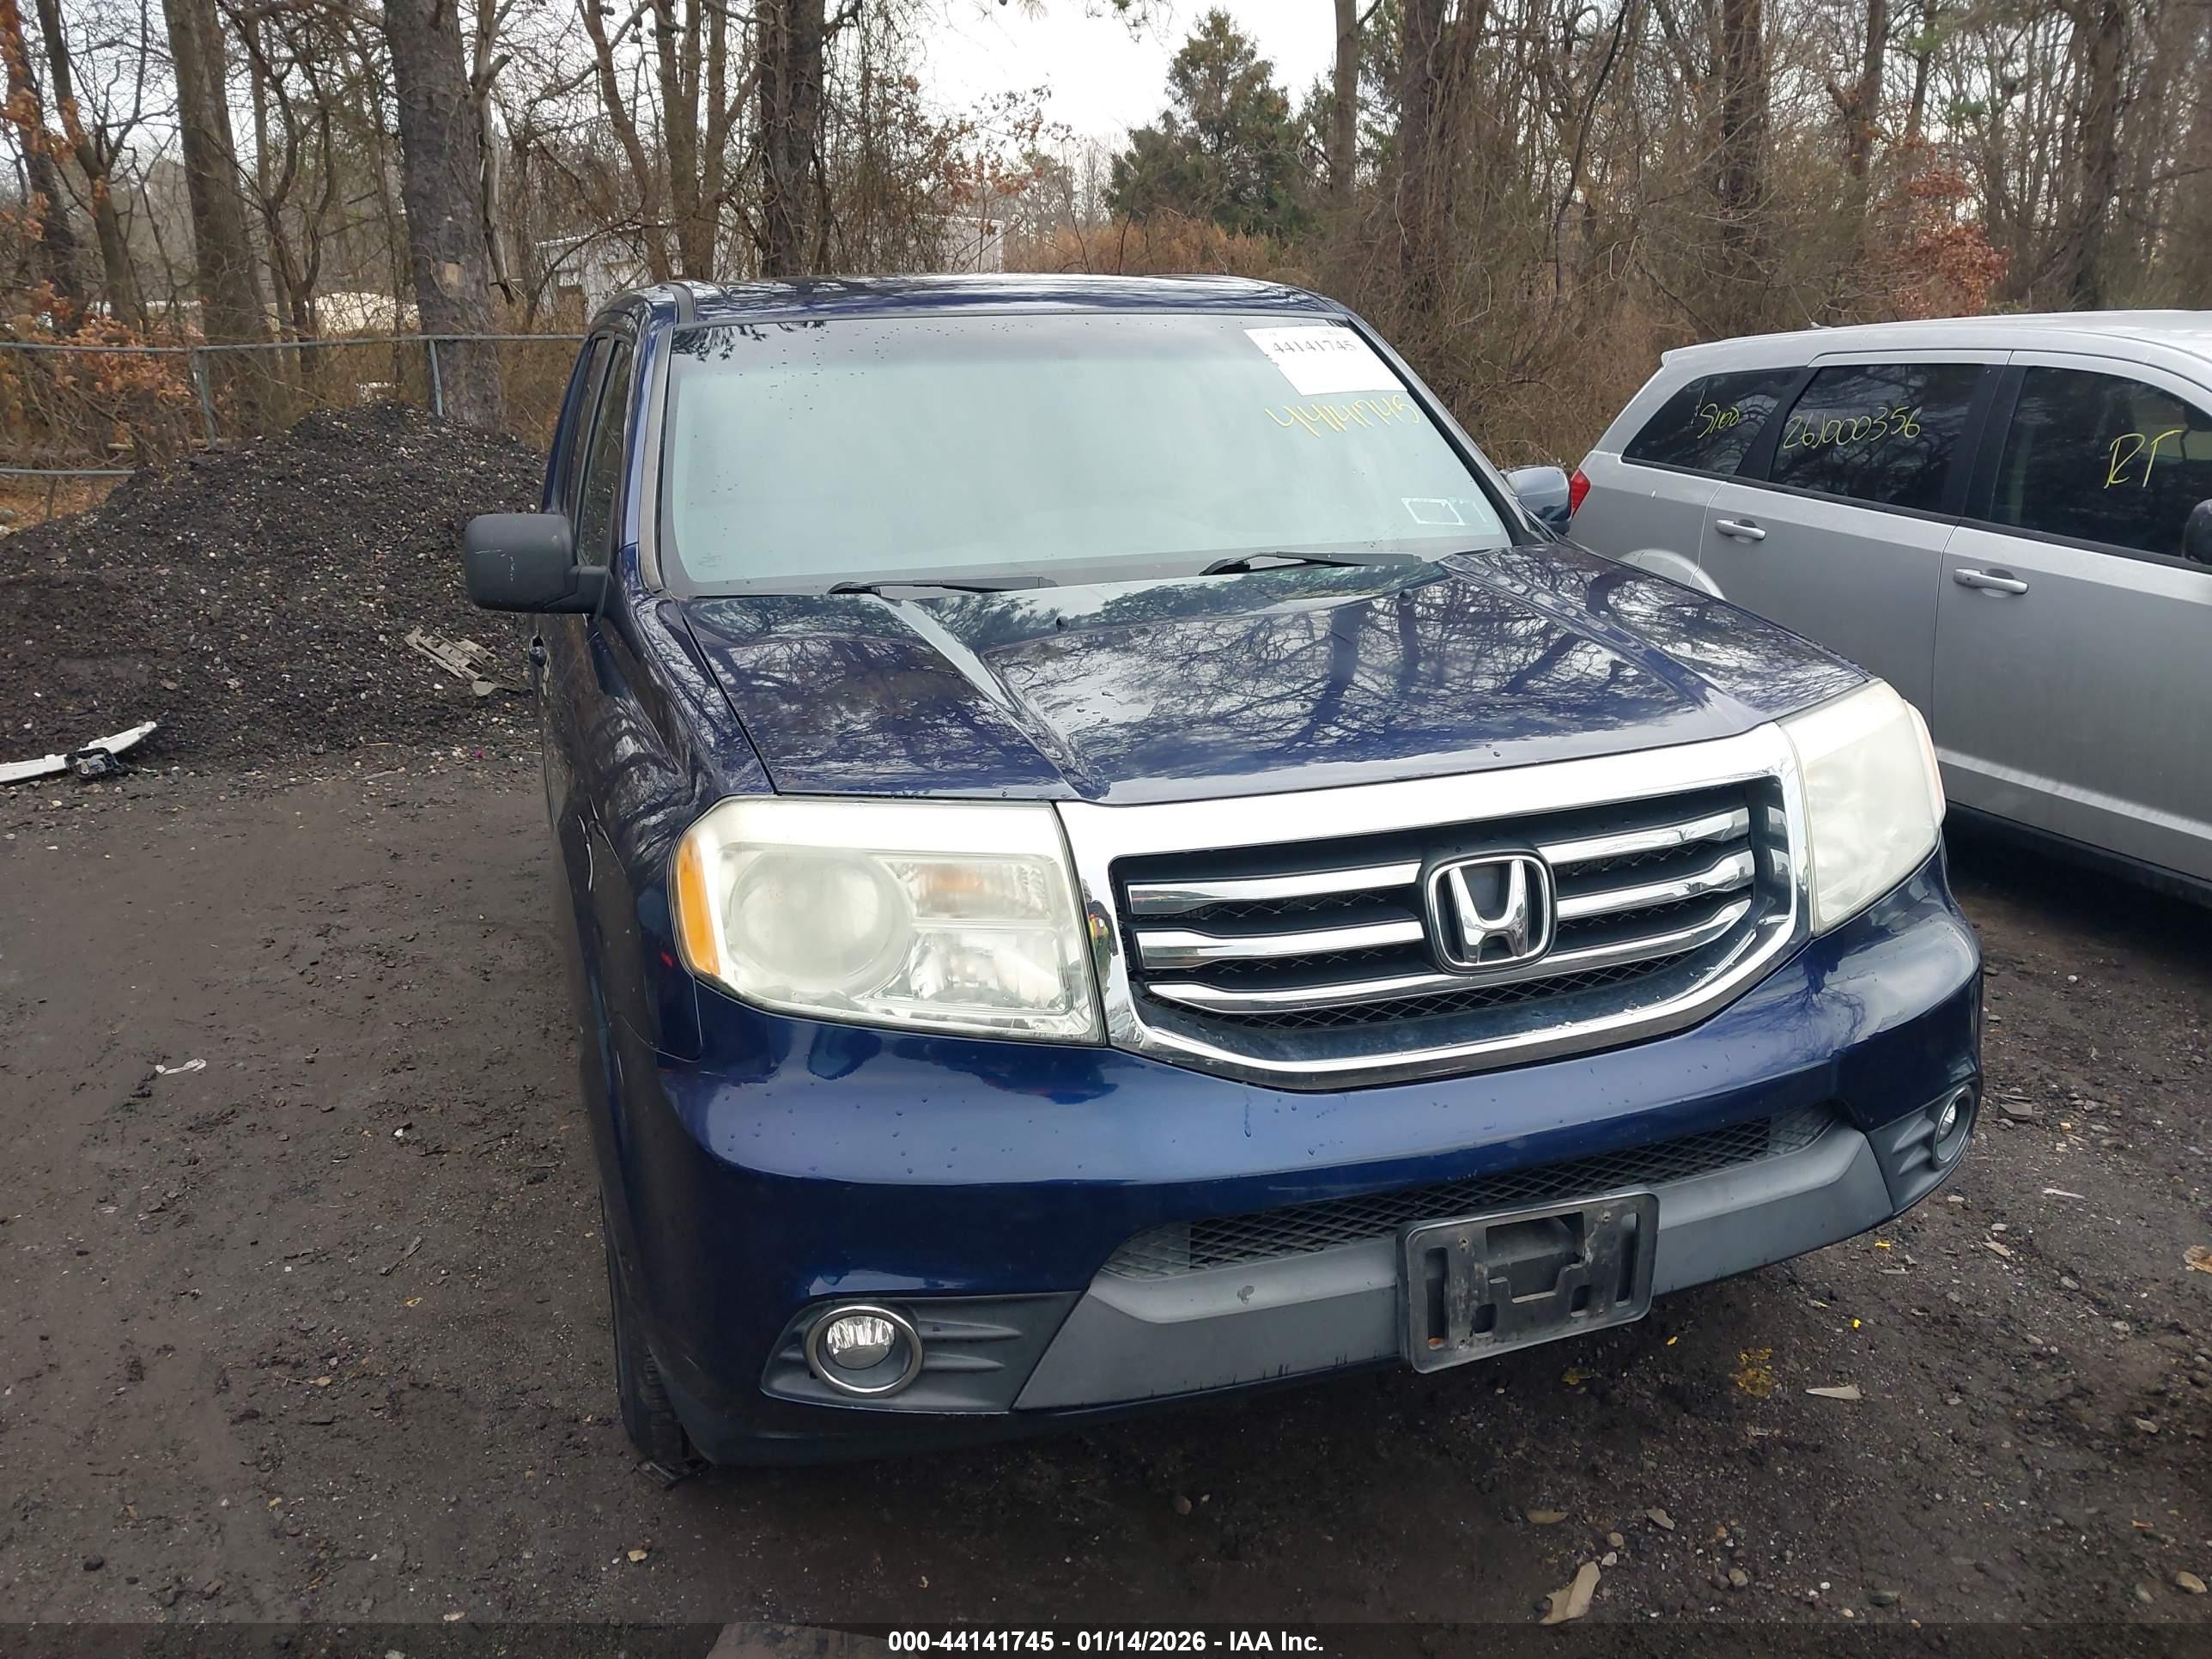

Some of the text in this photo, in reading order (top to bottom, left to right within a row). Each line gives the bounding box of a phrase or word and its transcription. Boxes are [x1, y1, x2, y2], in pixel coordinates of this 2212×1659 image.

[1272, 339, 1358, 353] 44141745
[1782, 405, 1923, 450] 261000356
[2103, 429, 2185, 489] RT
